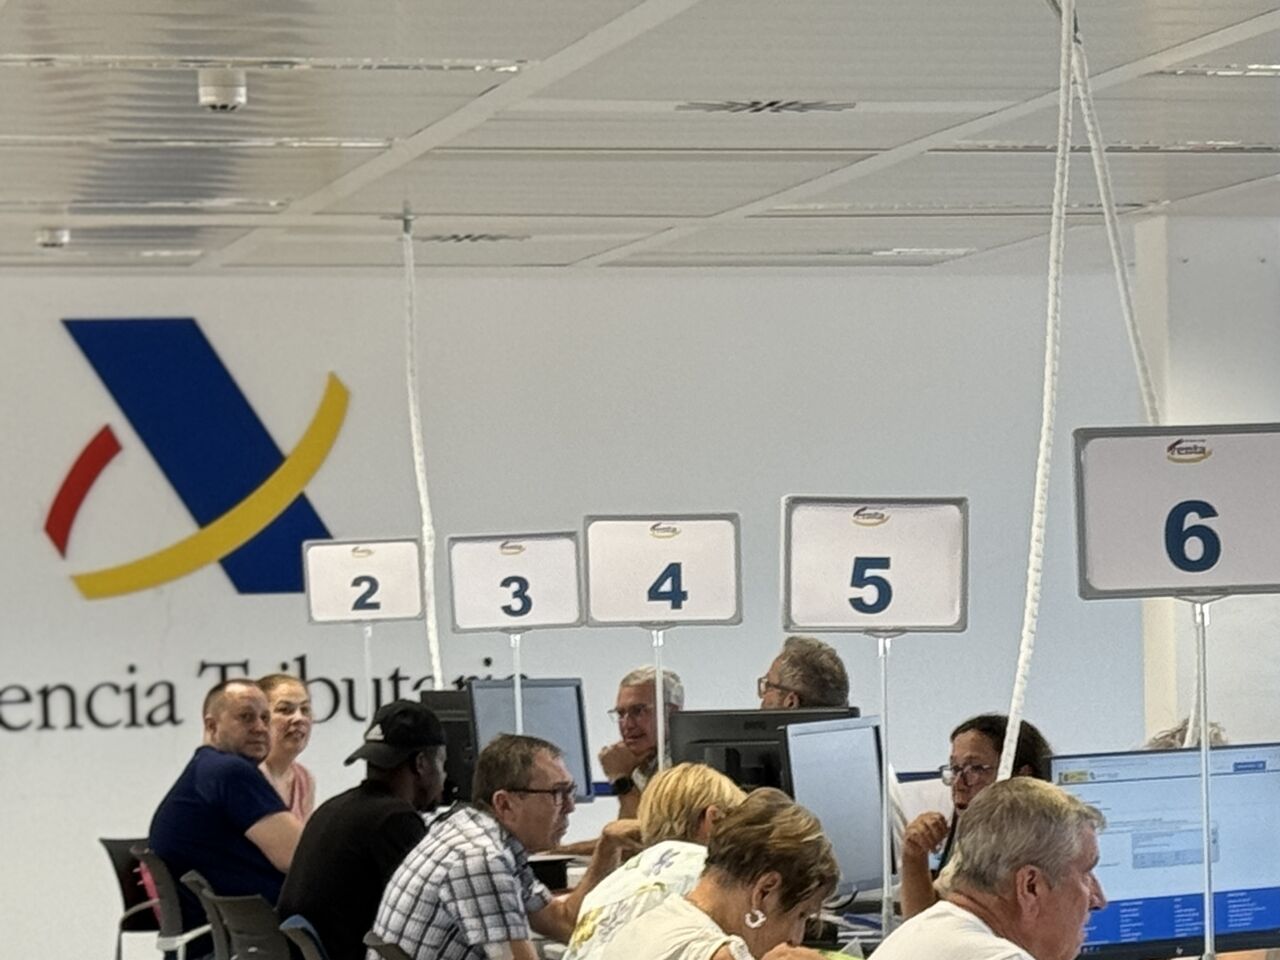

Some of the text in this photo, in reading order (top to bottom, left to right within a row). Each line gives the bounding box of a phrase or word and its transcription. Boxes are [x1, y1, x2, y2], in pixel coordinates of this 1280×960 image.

[1165, 500, 1221, 572] 6
[351, 576, 380, 610] 2
[500, 576, 532, 617] 3
[648, 563, 688, 609] 4
[849, 557, 892, 614] 5
[0, 664, 183, 732] encia
